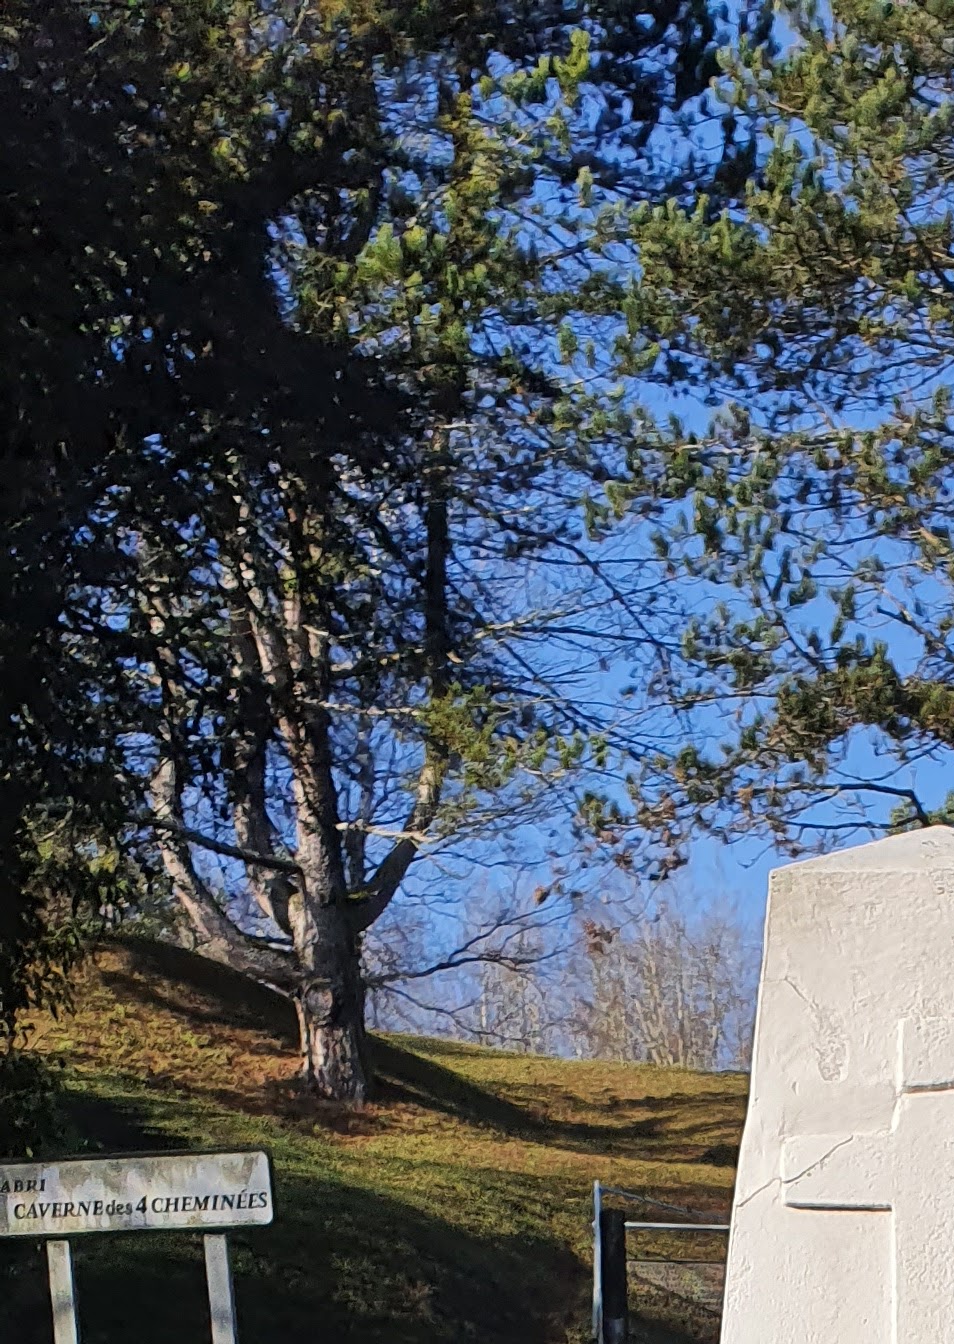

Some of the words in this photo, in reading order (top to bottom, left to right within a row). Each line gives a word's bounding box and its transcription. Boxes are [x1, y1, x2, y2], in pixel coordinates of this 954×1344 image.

[0, 1179, 46, 1193] ABRI
[14, 1200, 103, 1219] CAVERNE
[106, 1199, 132, 1216] des
[135, 1194, 148, 1214] 4
[151, 1189, 268, 1214] CHEMINÉES
